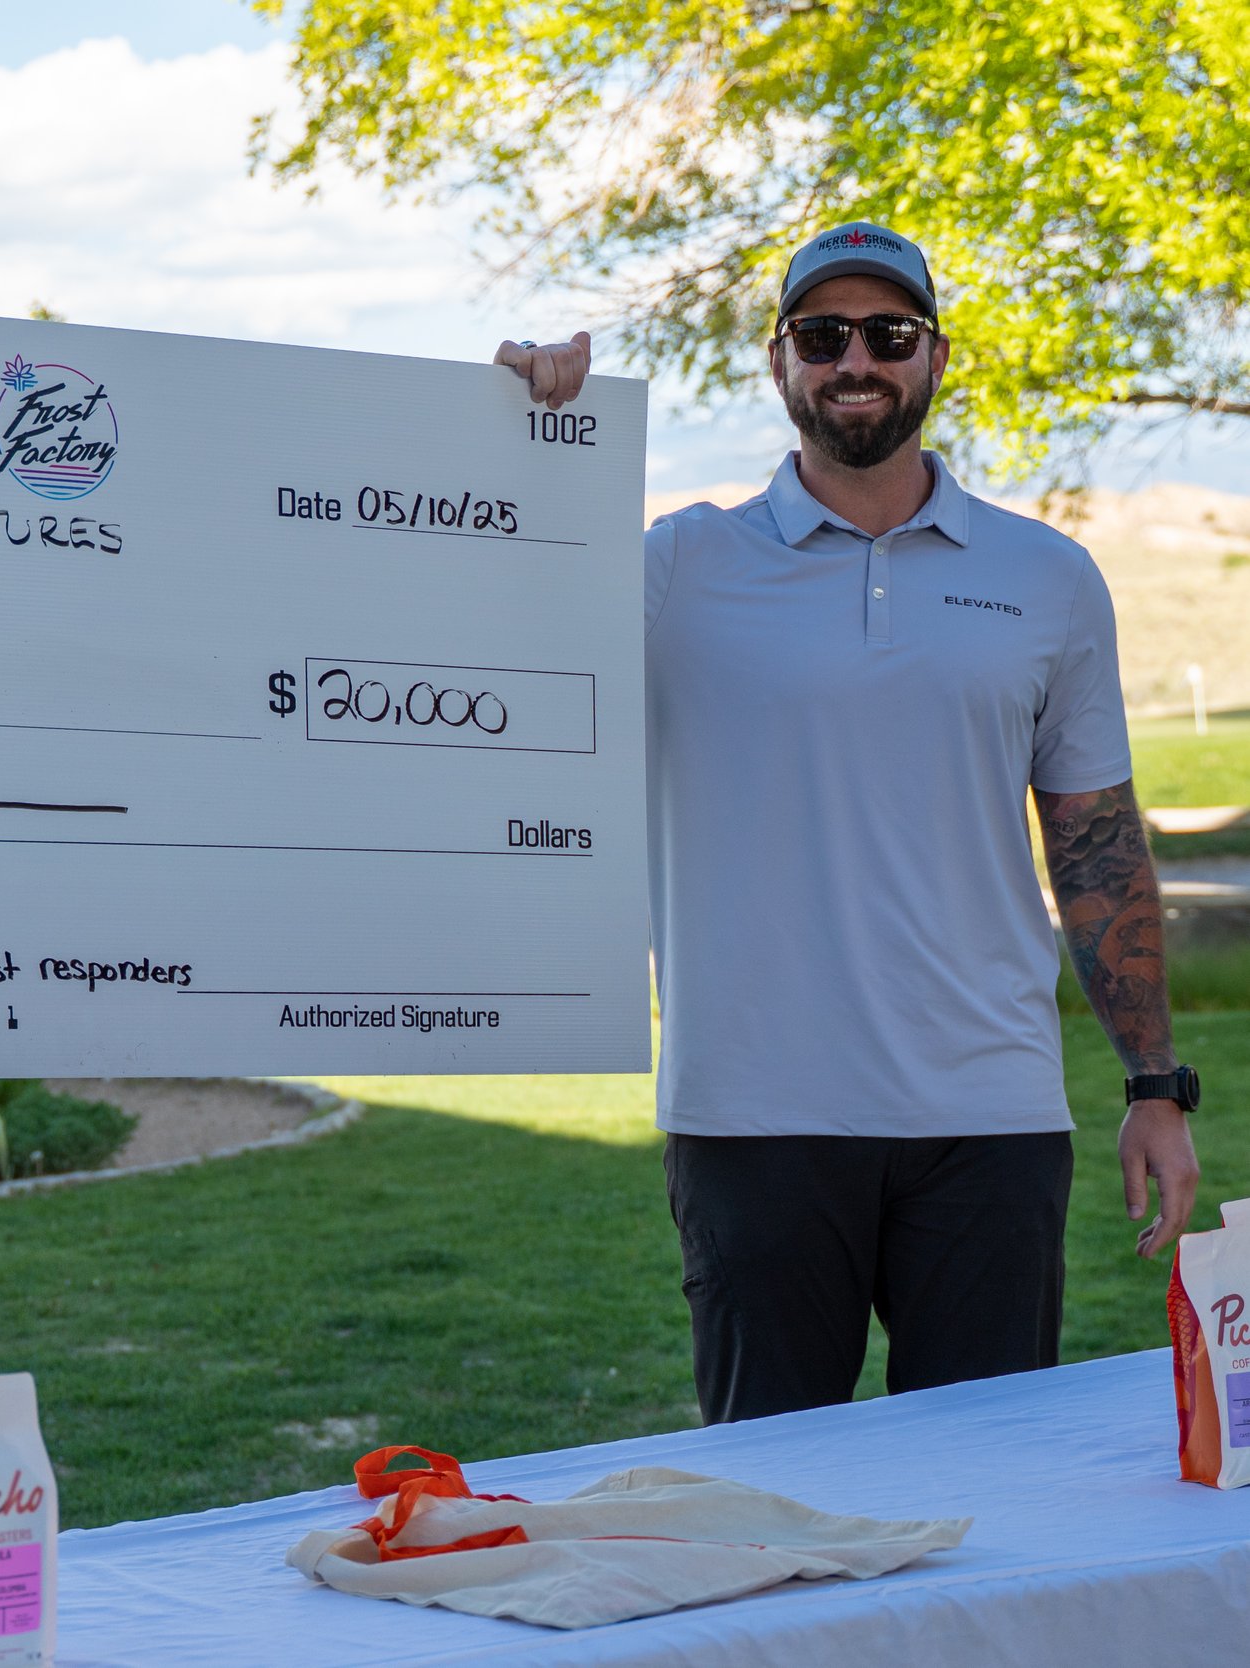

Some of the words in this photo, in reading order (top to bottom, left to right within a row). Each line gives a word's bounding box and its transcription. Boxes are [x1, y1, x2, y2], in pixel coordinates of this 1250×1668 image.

[818, 234, 848, 251] HERO
[864, 233, 902, 253] GROWN
[828, 244, 896, 253] FOUNDATION
[2, 382, 108, 440] Frost
[525, 410, 597, 447] 1002
[278, 487, 341, 521] Date
[355, 484, 520, 536] 05/10/25
[944, 595, 1022, 617] ELEVATED
[269, 670, 296, 718] $
[317, 668, 508, 734] 20,000
[507, 820, 592, 849] Dollars
[37, 954, 194, 994] responders
[279, 1004, 395, 1027] Authorized
[402, 1005, 499, 1032] Signature
